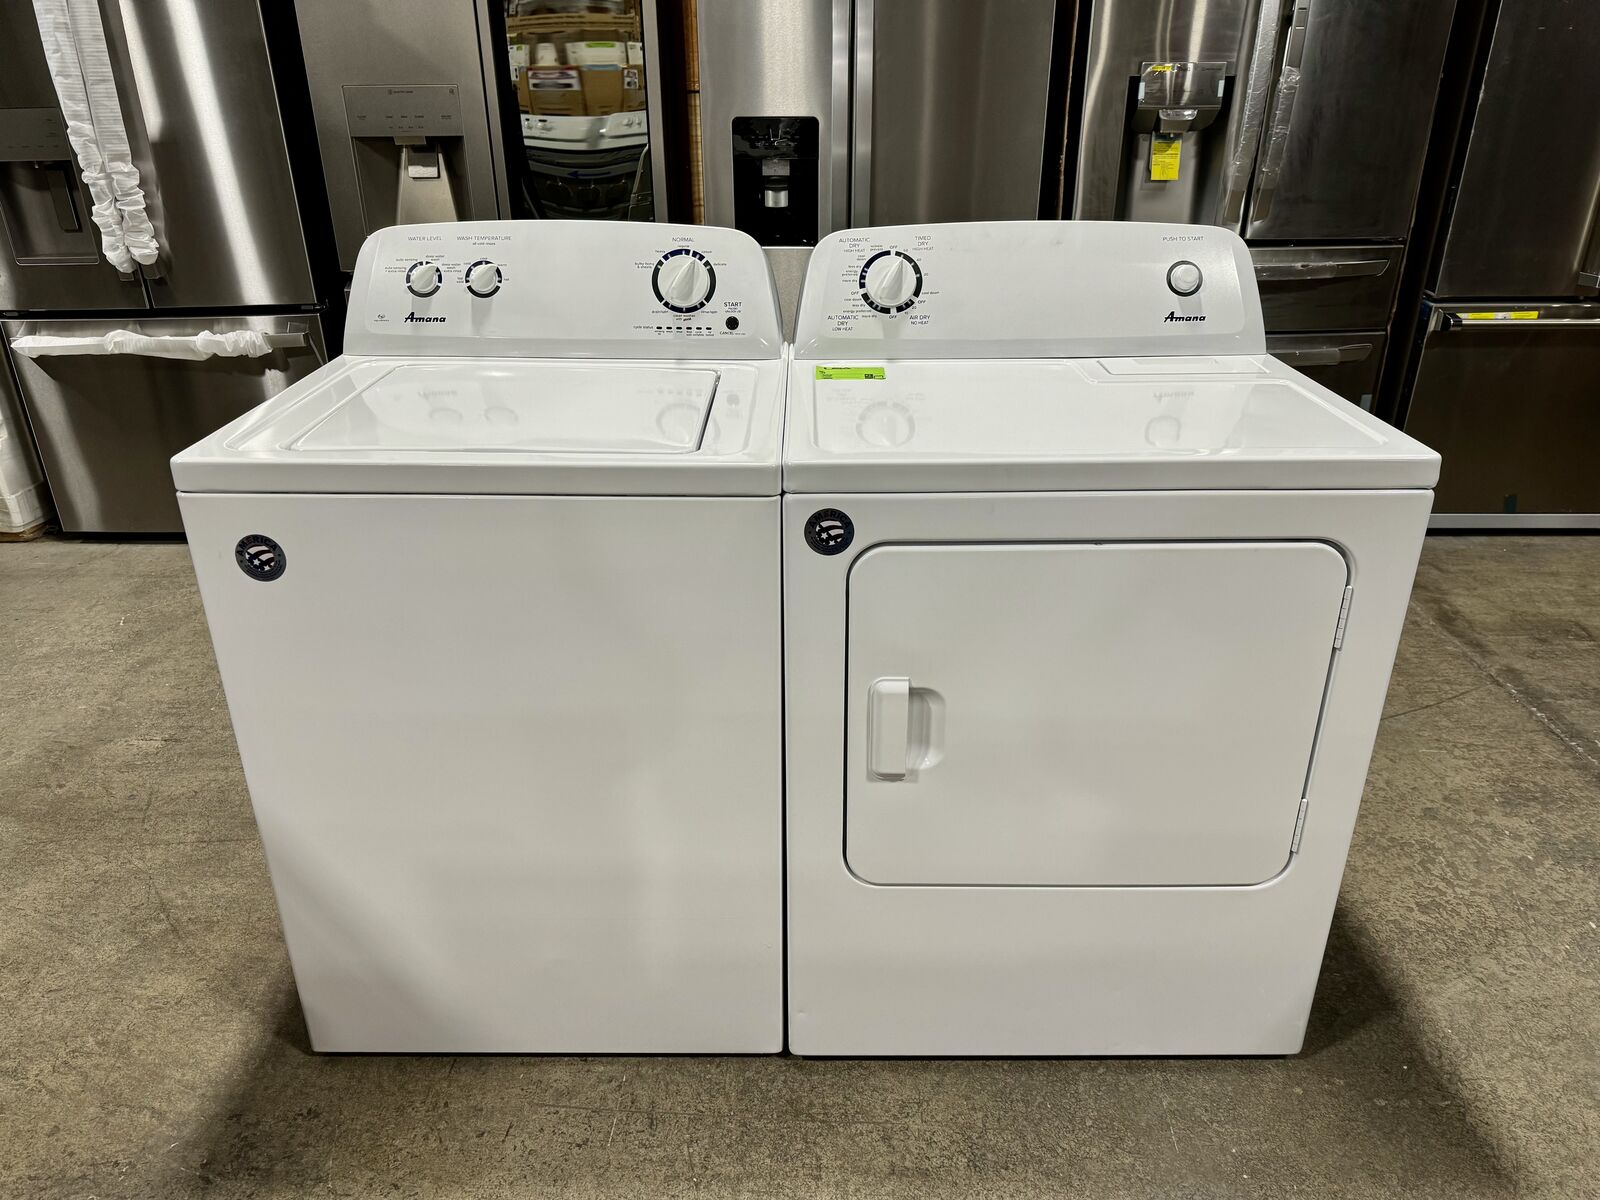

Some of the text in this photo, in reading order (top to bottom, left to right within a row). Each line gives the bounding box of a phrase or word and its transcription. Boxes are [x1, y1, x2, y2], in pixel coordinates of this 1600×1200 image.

[404, 312, 446, 323] Amana
[1164, 311, 1206, 322] Amana
[236, 536, 278, 556] AMERICA
